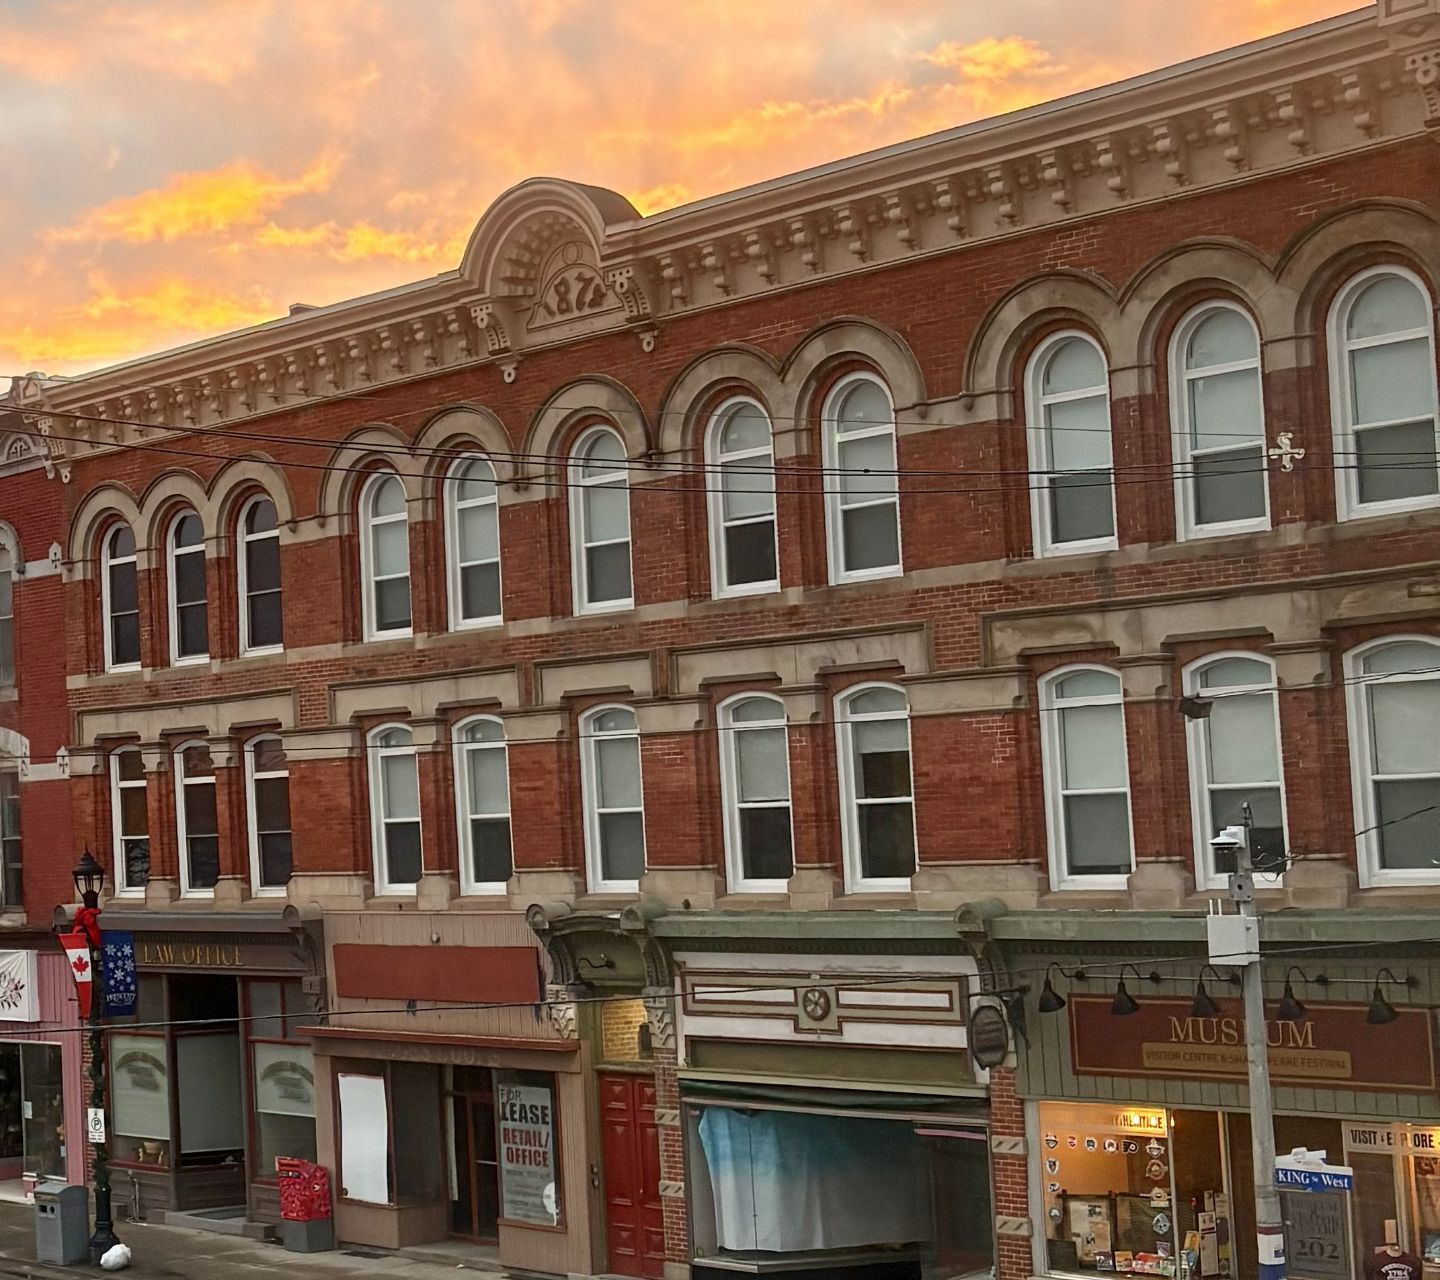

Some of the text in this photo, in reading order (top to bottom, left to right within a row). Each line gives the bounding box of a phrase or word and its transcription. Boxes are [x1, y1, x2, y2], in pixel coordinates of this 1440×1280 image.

[144, 944, 244, 966] LAW OFFICE
[1168, 1016, 1317, 1048] MUSUM
[1146, 1051, 1180, 1061] VISITOR
[1182, 1052, 1219, 1063] CENTRE
[1229, 1054, 1299, 1068] SHAPEARE
[1301, 1058, 1346, 1069] FESTIVAL
[500, 1088, 522, 1101] FOR
[501, 1102, 550, 1125] LEASE
[503, 1127, 549, 1149] RETAIL/
[1351, 1130, 1434, 1148] VISIT EPORE
[507, 1147, 549, 1167] OFFICE
[1278, 1170, 1310, 1184] KING
[1321, 1174, 1348, 1188] West
[1295, 1239, 1339, 1260] 202
